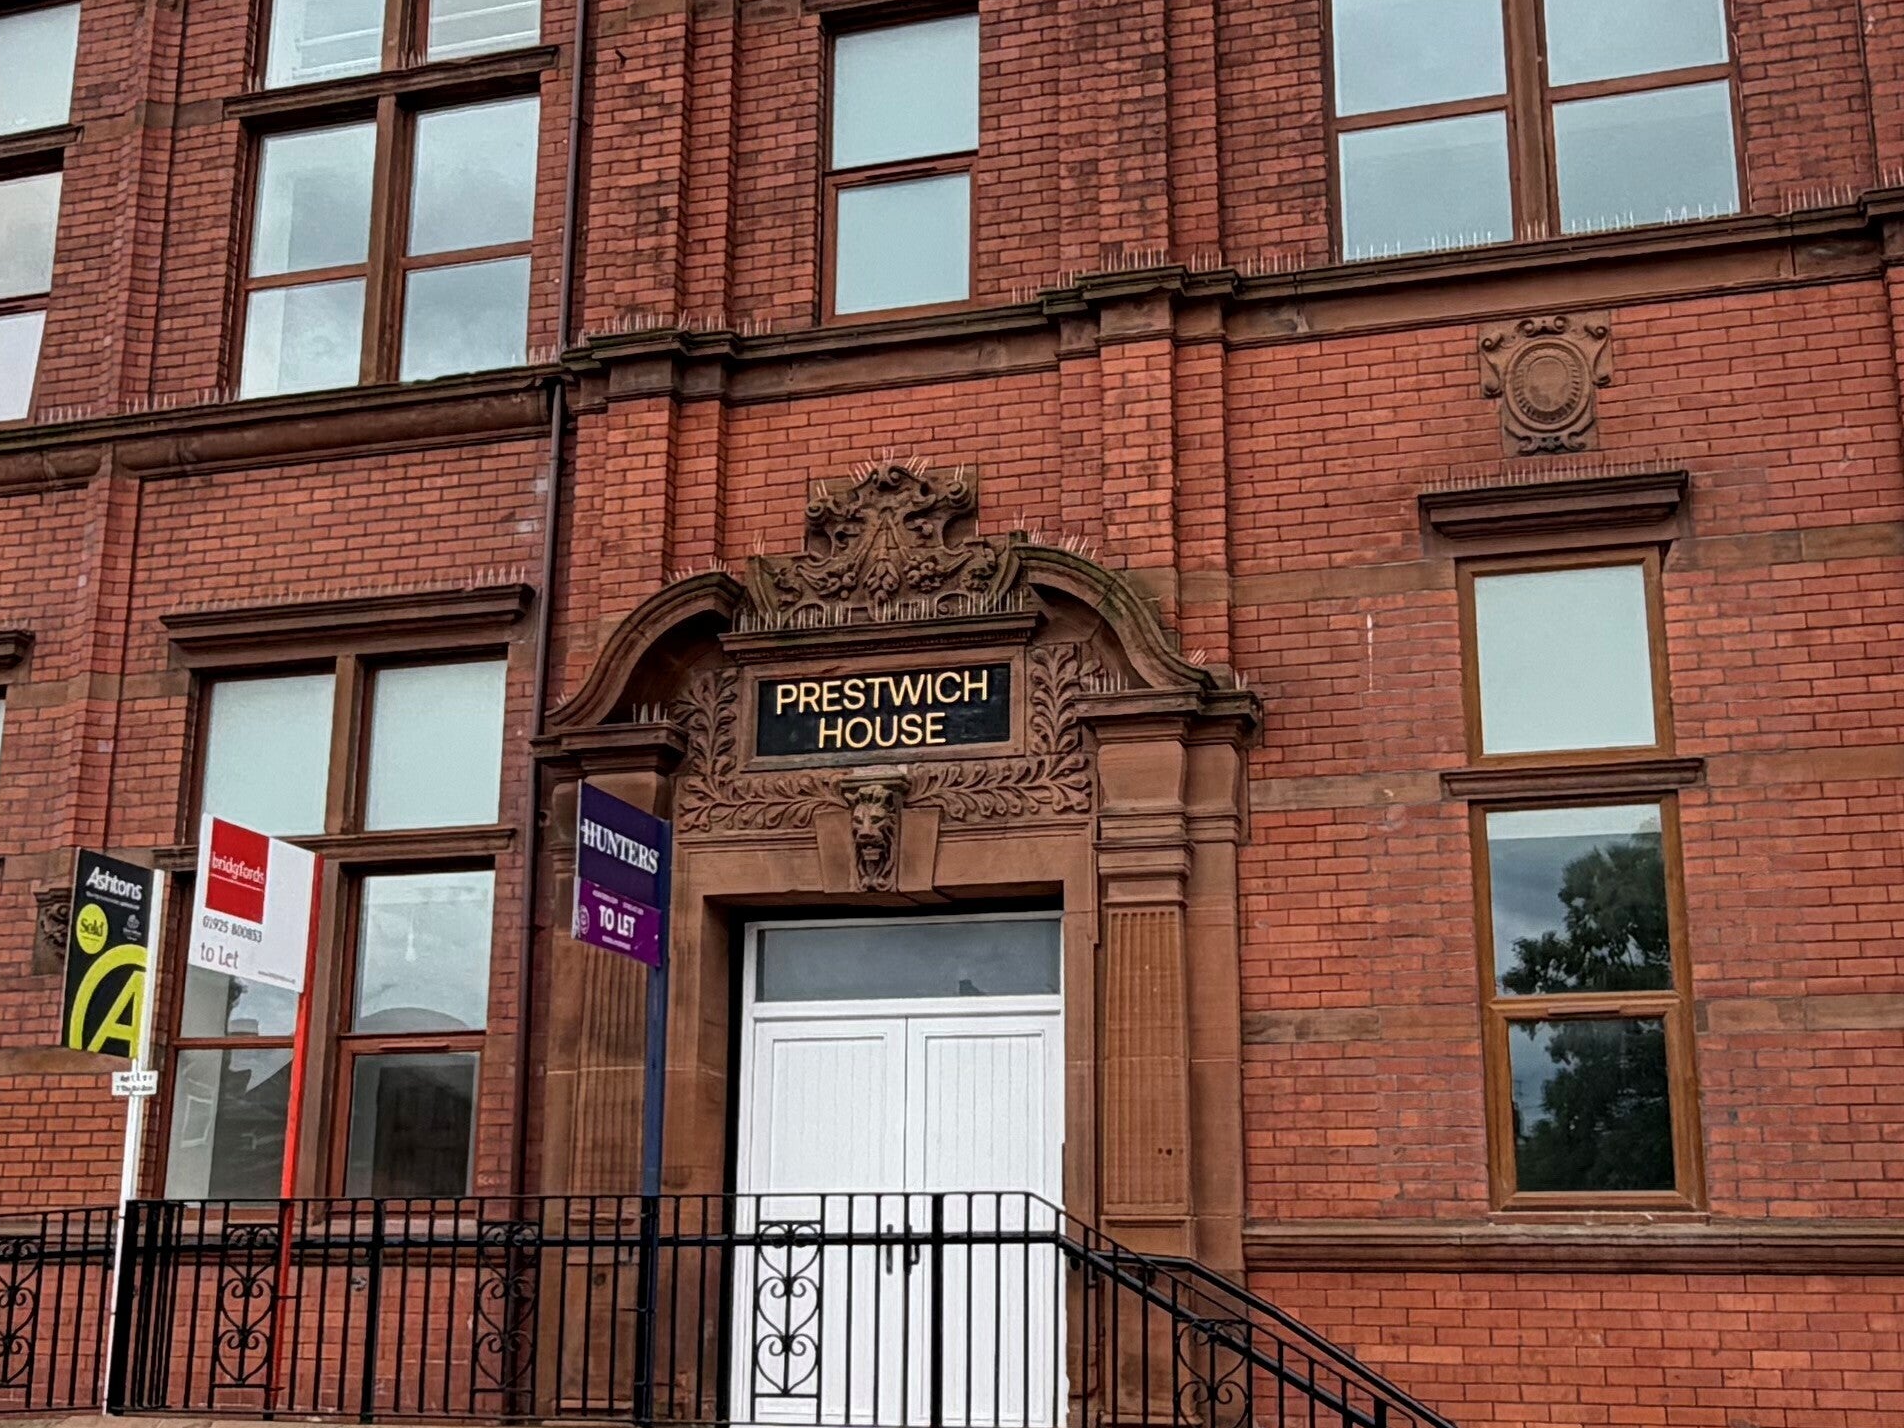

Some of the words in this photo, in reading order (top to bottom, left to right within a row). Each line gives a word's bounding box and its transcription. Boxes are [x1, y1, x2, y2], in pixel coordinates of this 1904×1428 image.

[776, 669, 988, 715] PRESTWICH
[818, 712, 946, 749] HOUSE
[581, 818, 660, 874] HUNTERS
[85, 866, 142, 901] Ashtons
[211, 851, 265, 884] bridgfords
[80, 918, 104, 937] Sold
[598, 904, 615, 931] TO
[617, 912, 636, 938] LET
[200, 941, 215, 963] to
